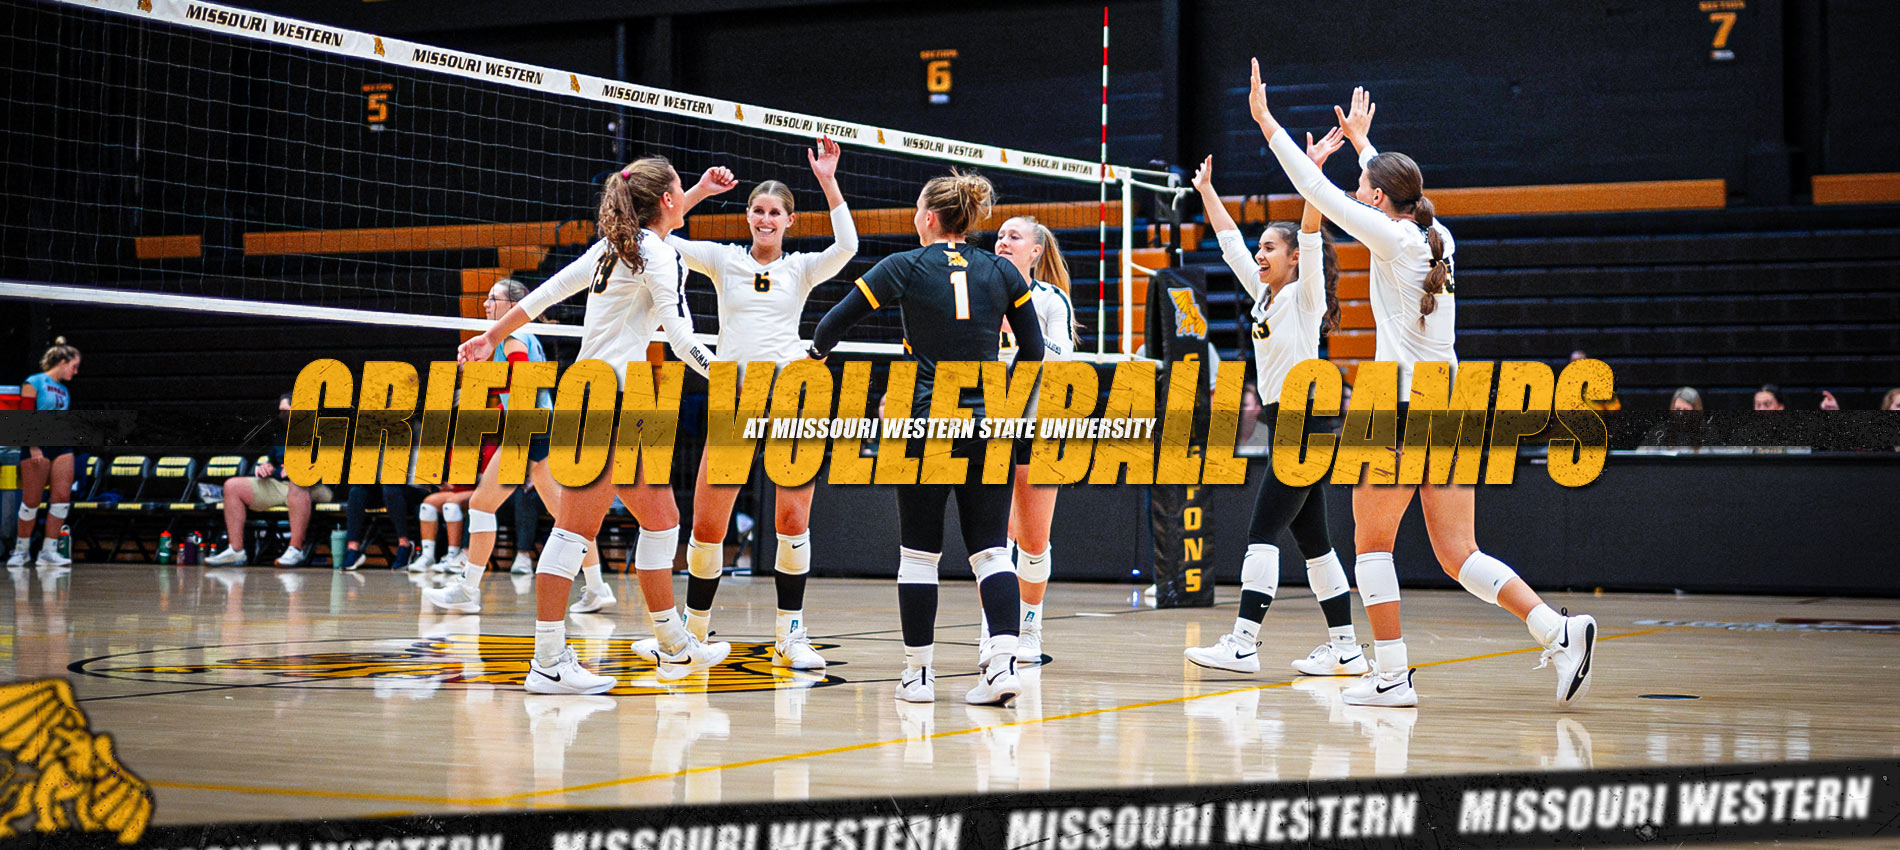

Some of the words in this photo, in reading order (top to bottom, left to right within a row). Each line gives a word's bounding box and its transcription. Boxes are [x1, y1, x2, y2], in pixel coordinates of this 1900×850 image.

[186, 4, 267, 32] MISSOURI
[272, 21, 344, 47] WESTERN
[1709, 12, 1736, 48] 7
[412, 48, 481, 73] MISSOURI
[485, 62, 543, 84] WESTERN
[927, 60, 952, 92] 6
[368, 93, 388, 122] 5
[602, 84, 660, 105] MISSOURI
[663, 94, 714, 115] WESTERN
[763, 112, 812, 131] MISSOURI
[816, 121, 859, 139] WESTERN
[754, 271, 771, 293] 6
[950, 270, 971, 320] 1
